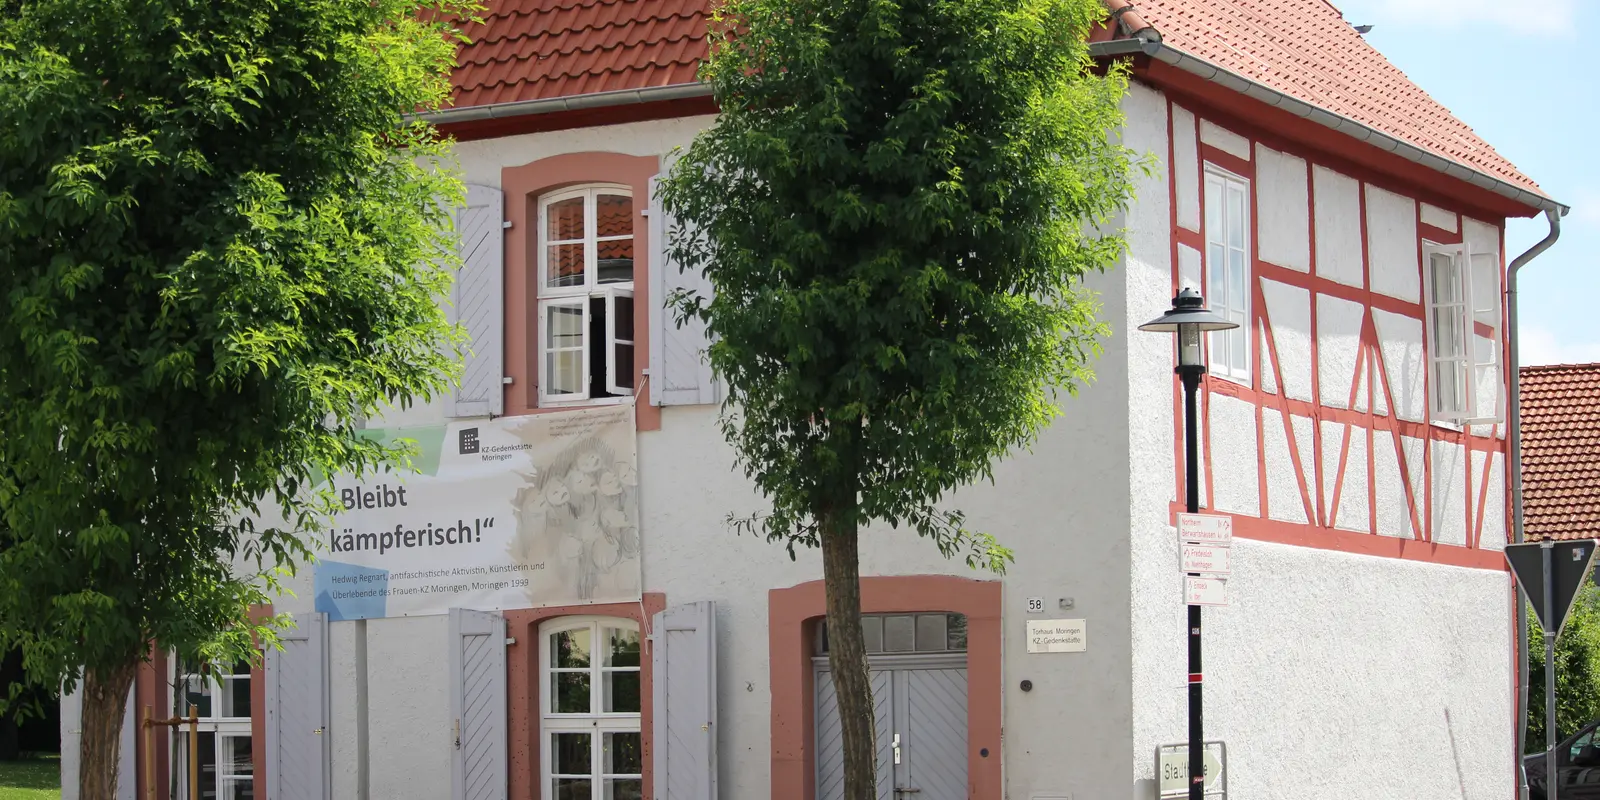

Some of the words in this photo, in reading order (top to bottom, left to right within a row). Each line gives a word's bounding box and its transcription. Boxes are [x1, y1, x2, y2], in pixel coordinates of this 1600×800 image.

[481, 443, 533, 453] KZ-Gedenkstätte
[481, 453, 512, 461] Moringen
[330, 517, 495, 555] kämpferisch!“
[332, 575, 358, 585] Hedwig
[360, 573, 389, 583] Regnart,
[390, 568, 450, 580] antifaschistische
[452, 566, 488, 575] Aktivistin,
[489, 562, 529, 573] Künstlerin
[530, 562, 545, 570] und
[332, 589, 377, 599] Überlebende
[378, 588, 391, 597] des
[392, 585, 430, 595] Frauen-KZ
[431, 584, 470, 593] Moringen,
[471, 580, 509, 590] Moringen
[511, 578, 529, 588] 1999
[1029, 599, 1042, 610] 58
[1032, 628, 1053, 636] Torhaus
[1055, 627, 1081, 636] Moringen
